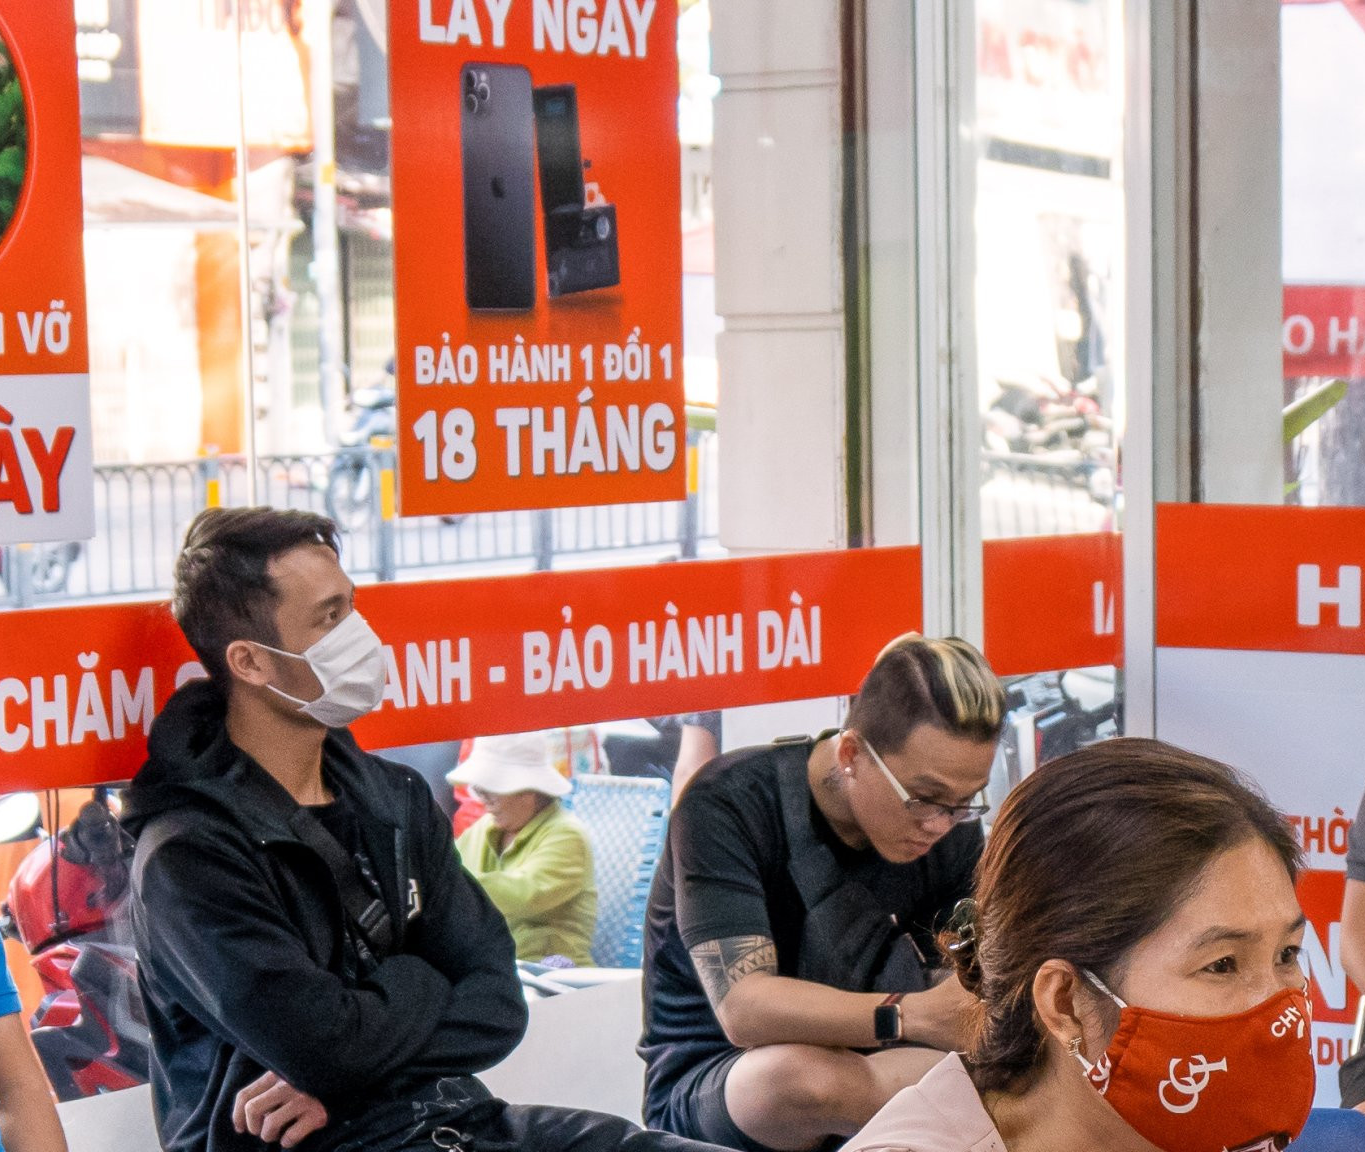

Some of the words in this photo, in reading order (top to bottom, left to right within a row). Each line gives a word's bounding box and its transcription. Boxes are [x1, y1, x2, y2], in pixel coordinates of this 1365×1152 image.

[18, 300, 71, 353] VỠ
[416, 333, 477, 384] BẢO
[489, 336, 570, 382] HÀNH
[581, 345, 592, 380] 1
[603, 327, 651, 380] ĐỔI
[660, 344, 671, 379] 1
[414, 408, 477, 480] 18
[496, 387, 675, 476] THÁNG
[523, 606, 612, 694] BẢO
[629, 603, 742, 683] HÀNH
[758, 592, 821, 669] DÀI
